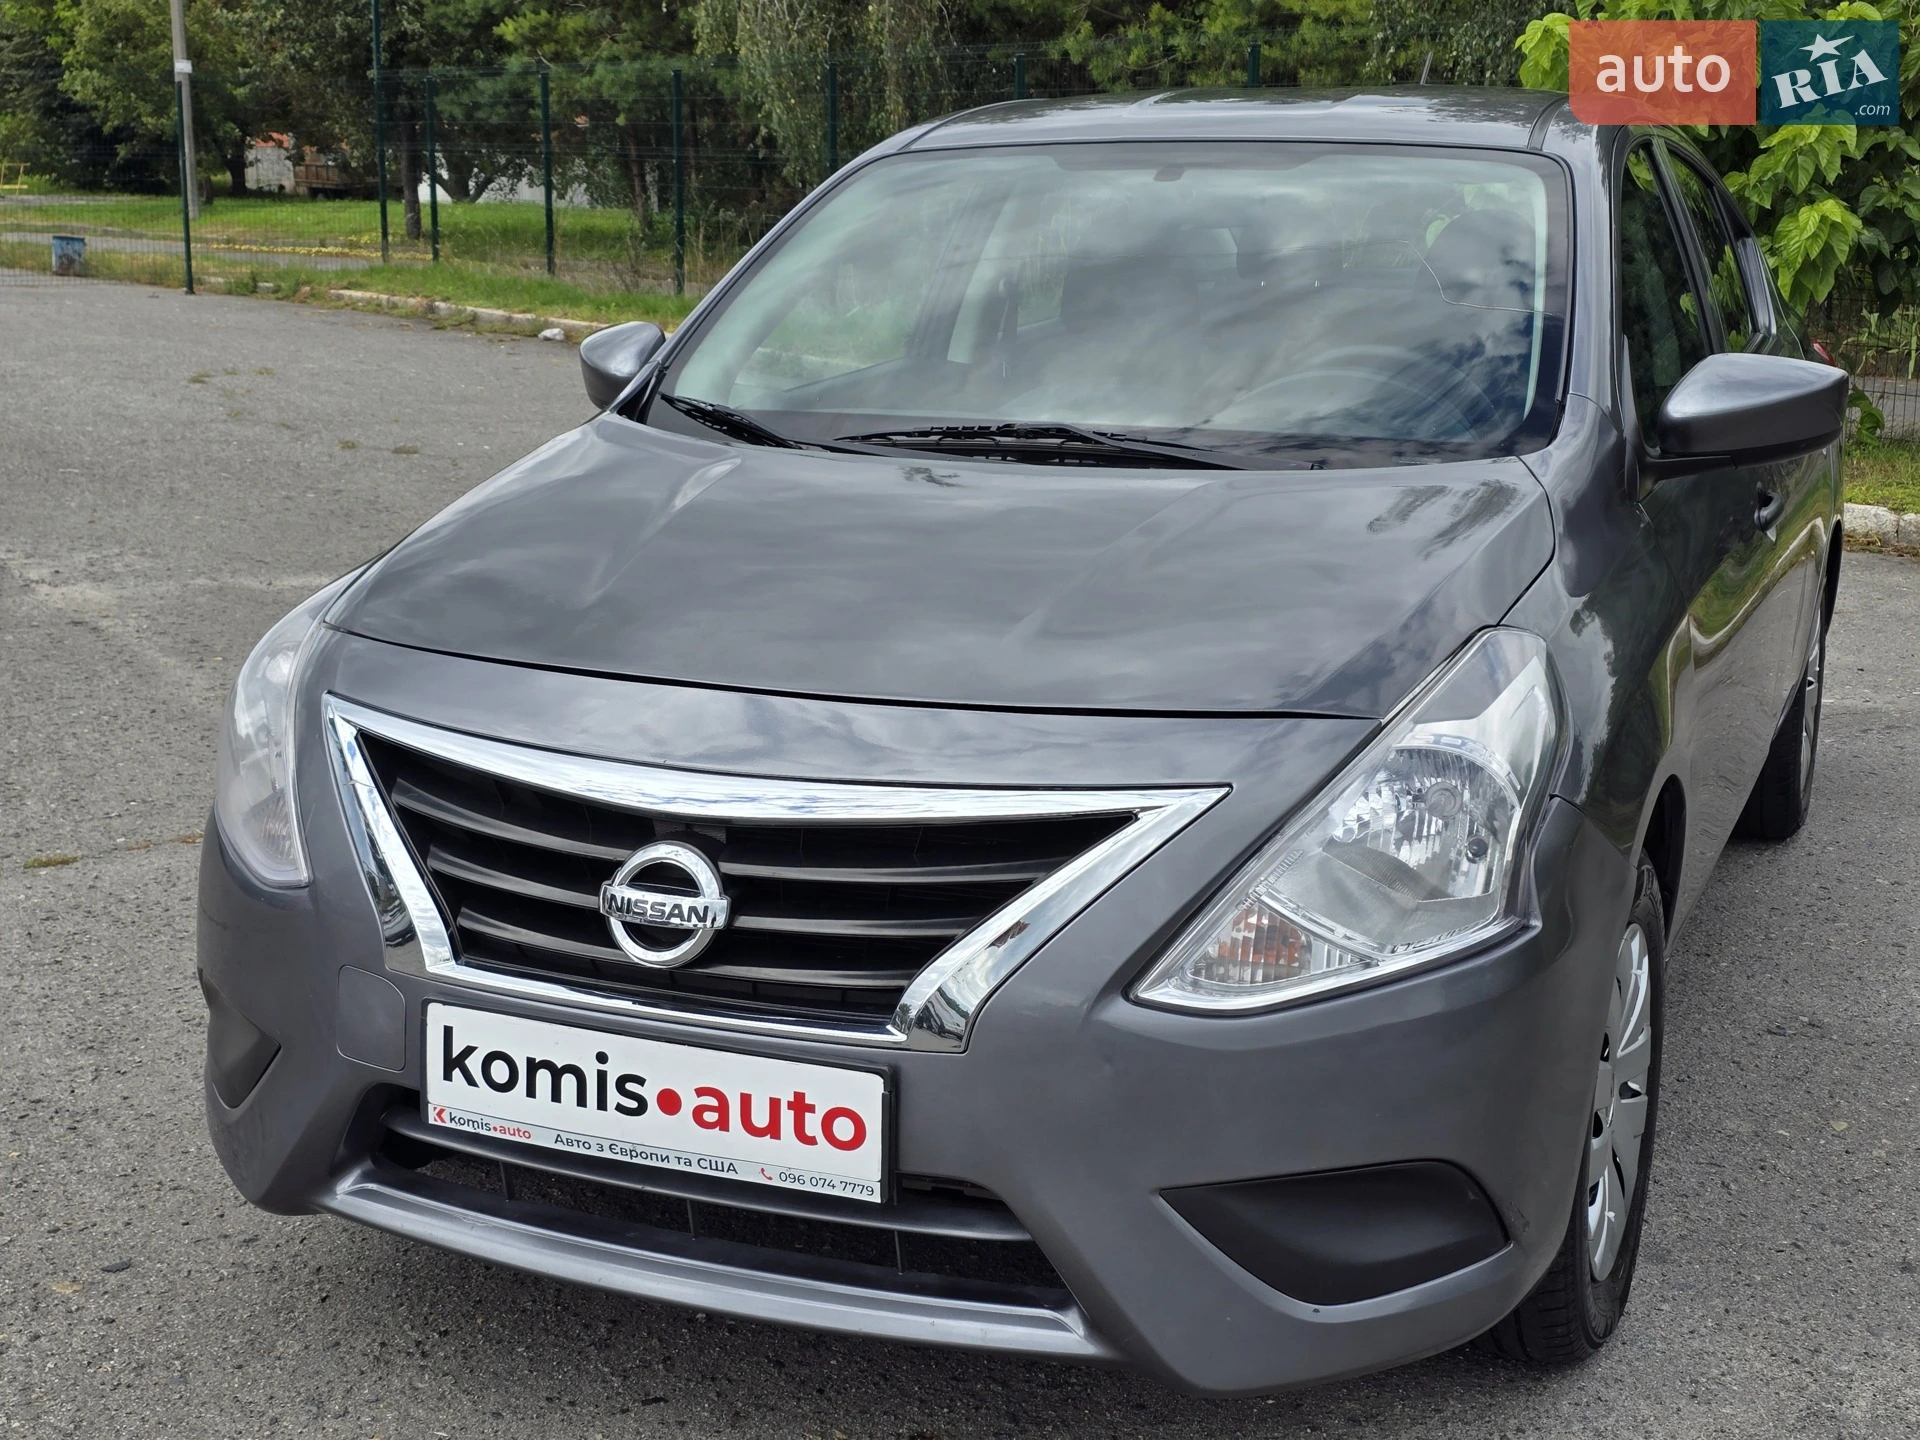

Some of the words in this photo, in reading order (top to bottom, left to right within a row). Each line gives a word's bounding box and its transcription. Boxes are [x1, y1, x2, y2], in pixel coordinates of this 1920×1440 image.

[608, 893, 709, 923] NISSAN
[554, 1133, 592, 1151] Авто
[609, 1143, 670, 1164] Європи
[675, 1156, 692, 1167] та
[697, 1158, 738, 1175] США
[779, 1171, 806, 1186] 096
[810, 1176, 837, 1190] 074
[840, 1180, 875, 1197] 7779
